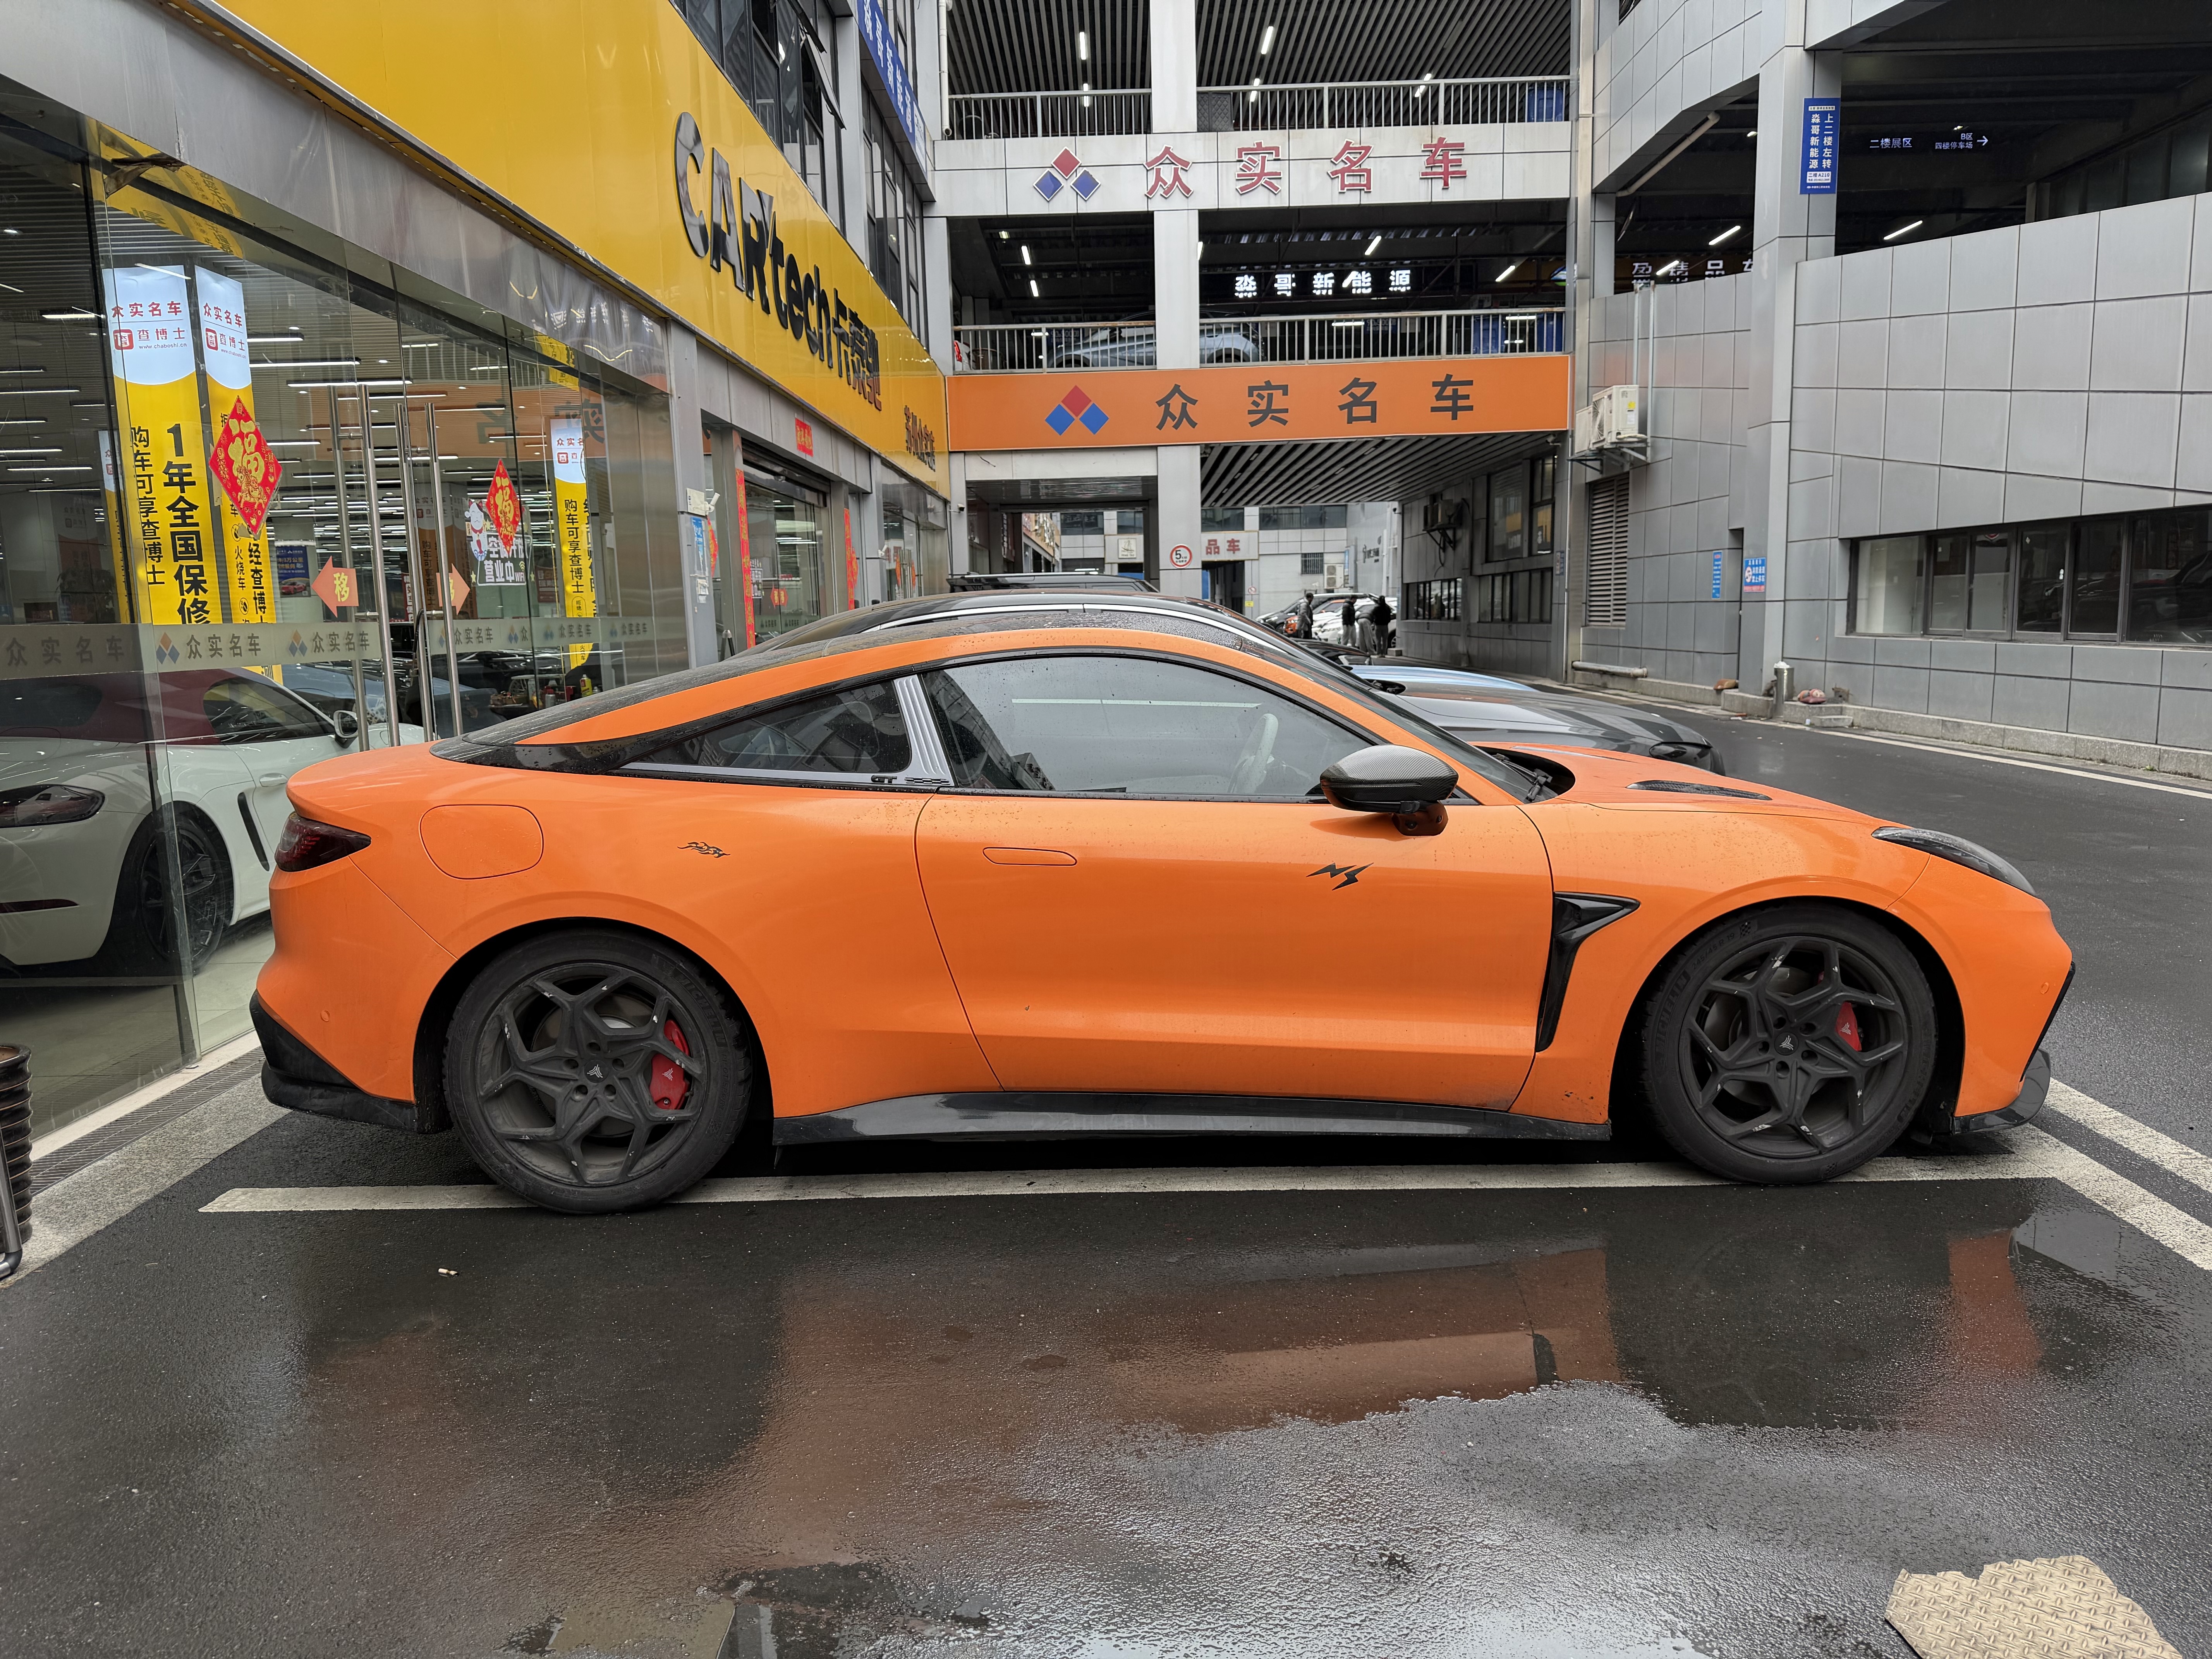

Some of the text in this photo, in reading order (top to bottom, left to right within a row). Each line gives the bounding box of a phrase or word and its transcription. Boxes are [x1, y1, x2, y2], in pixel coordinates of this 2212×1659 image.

[1809, 113, 1820, 168] 淼哥新能源
[1822, 113, 1834, 168] 上二楼左转
[1870, 138, 1912, 149] 二楼展区
[1142, 136, 1468, 199] 众实名车
[111, 301, 182, 318] 众实名车
[203, 302, 242, 328] 众实名车
[137, 327, 185, 341] 查博士
[219, 333, 245, 351] 查博士
[833, 288, 882, 411] 卡泰驰
[1155, 373, 1475, 431] 众实名车
[228, 419, 265, 484] 福
[162, 423, 211, 624] 1年全国保修
[564, 499, 584, 593] 购车可享查博士
[1175, 550, 1182, 560] 5
[235, 546, 246, 590] 火烧车
[484, 560, 515, 582] 营业中
[333, 572, 349, 602] 移
[313, 631, 369, 653] 众实名车
[454, 626, 493, 645] 众实名车
[559, 623, 591, 638] 众实名车
[5, 635, 124, 666] 众实名车
[186, 633, 261, 659] 众实名车
[871, 775, 897, 783] GT
[1692, 944, 1720, 970] 245/45
